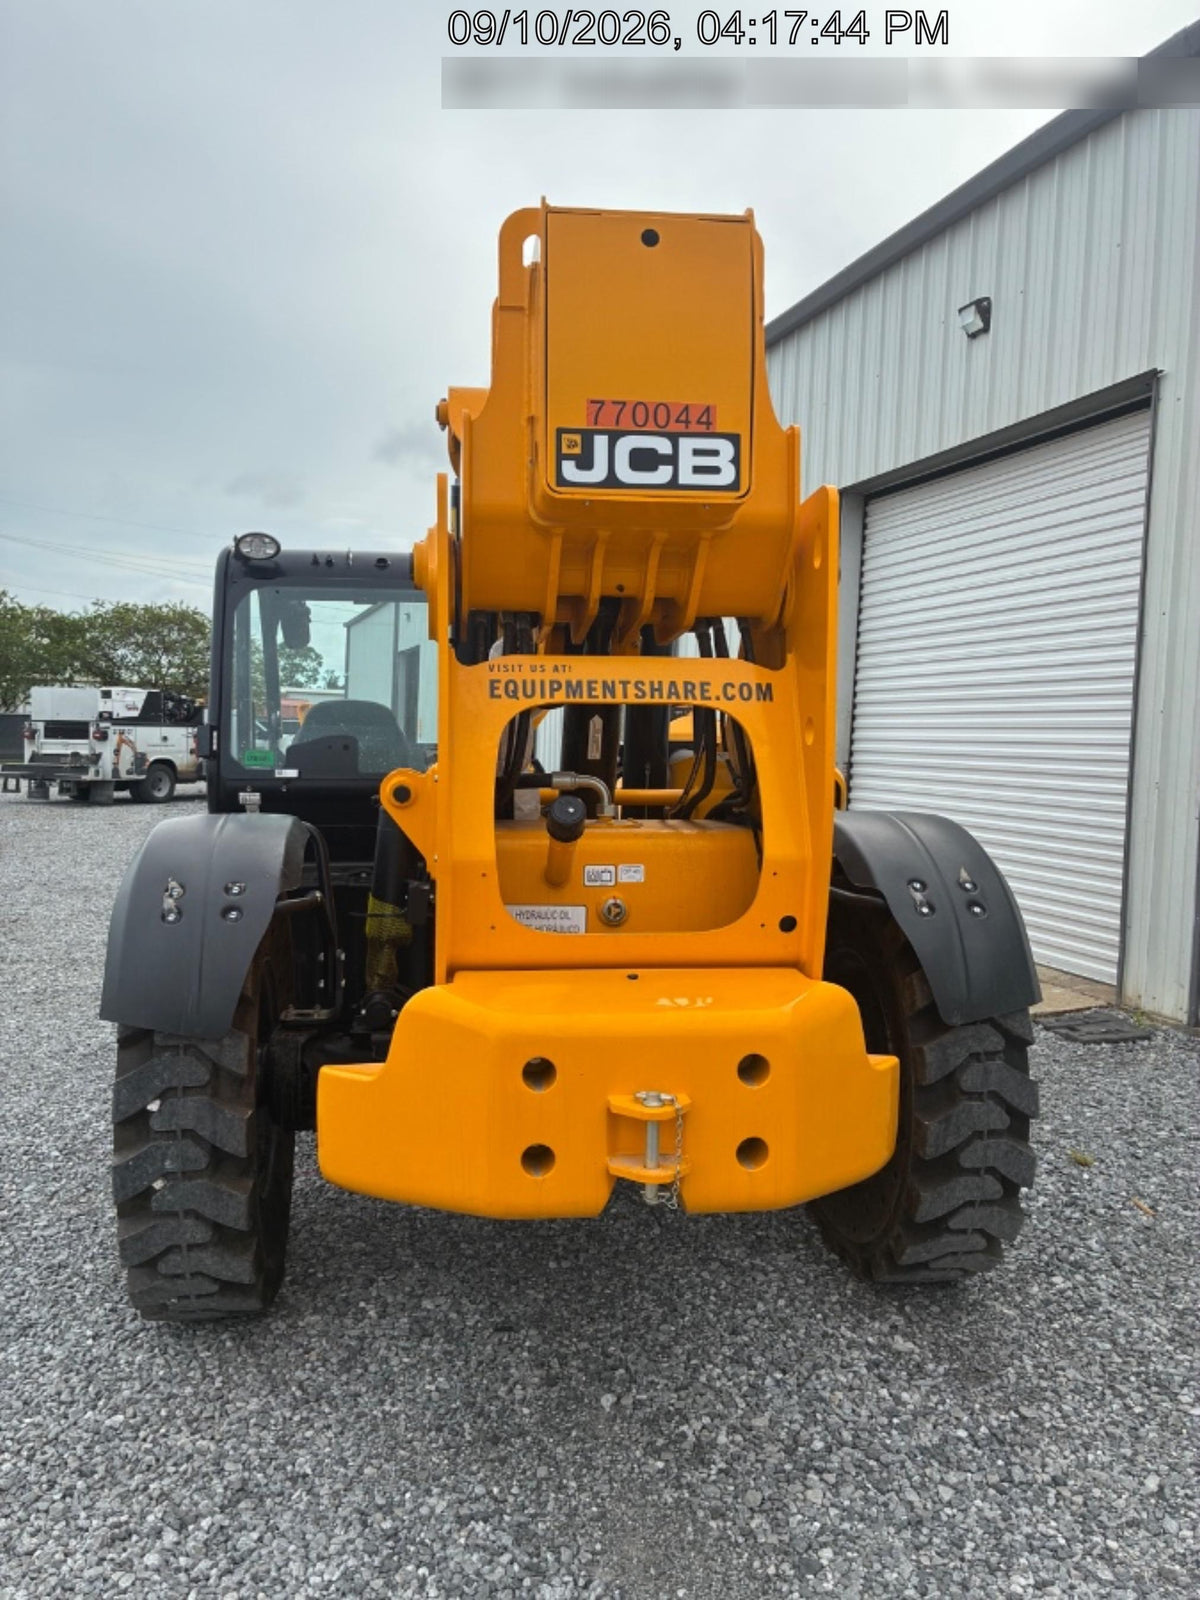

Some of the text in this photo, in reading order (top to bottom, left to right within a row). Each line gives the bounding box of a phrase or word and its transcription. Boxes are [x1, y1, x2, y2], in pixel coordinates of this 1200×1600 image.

[589, 400, 713, 431] 770044
[561, 434, 737, 486] JCB
[488, 664, 523, 673] VISIT
[529, 664, 546, 673] US
[488, 678, 773, 703] EQUIPMENTSHARE.COM
